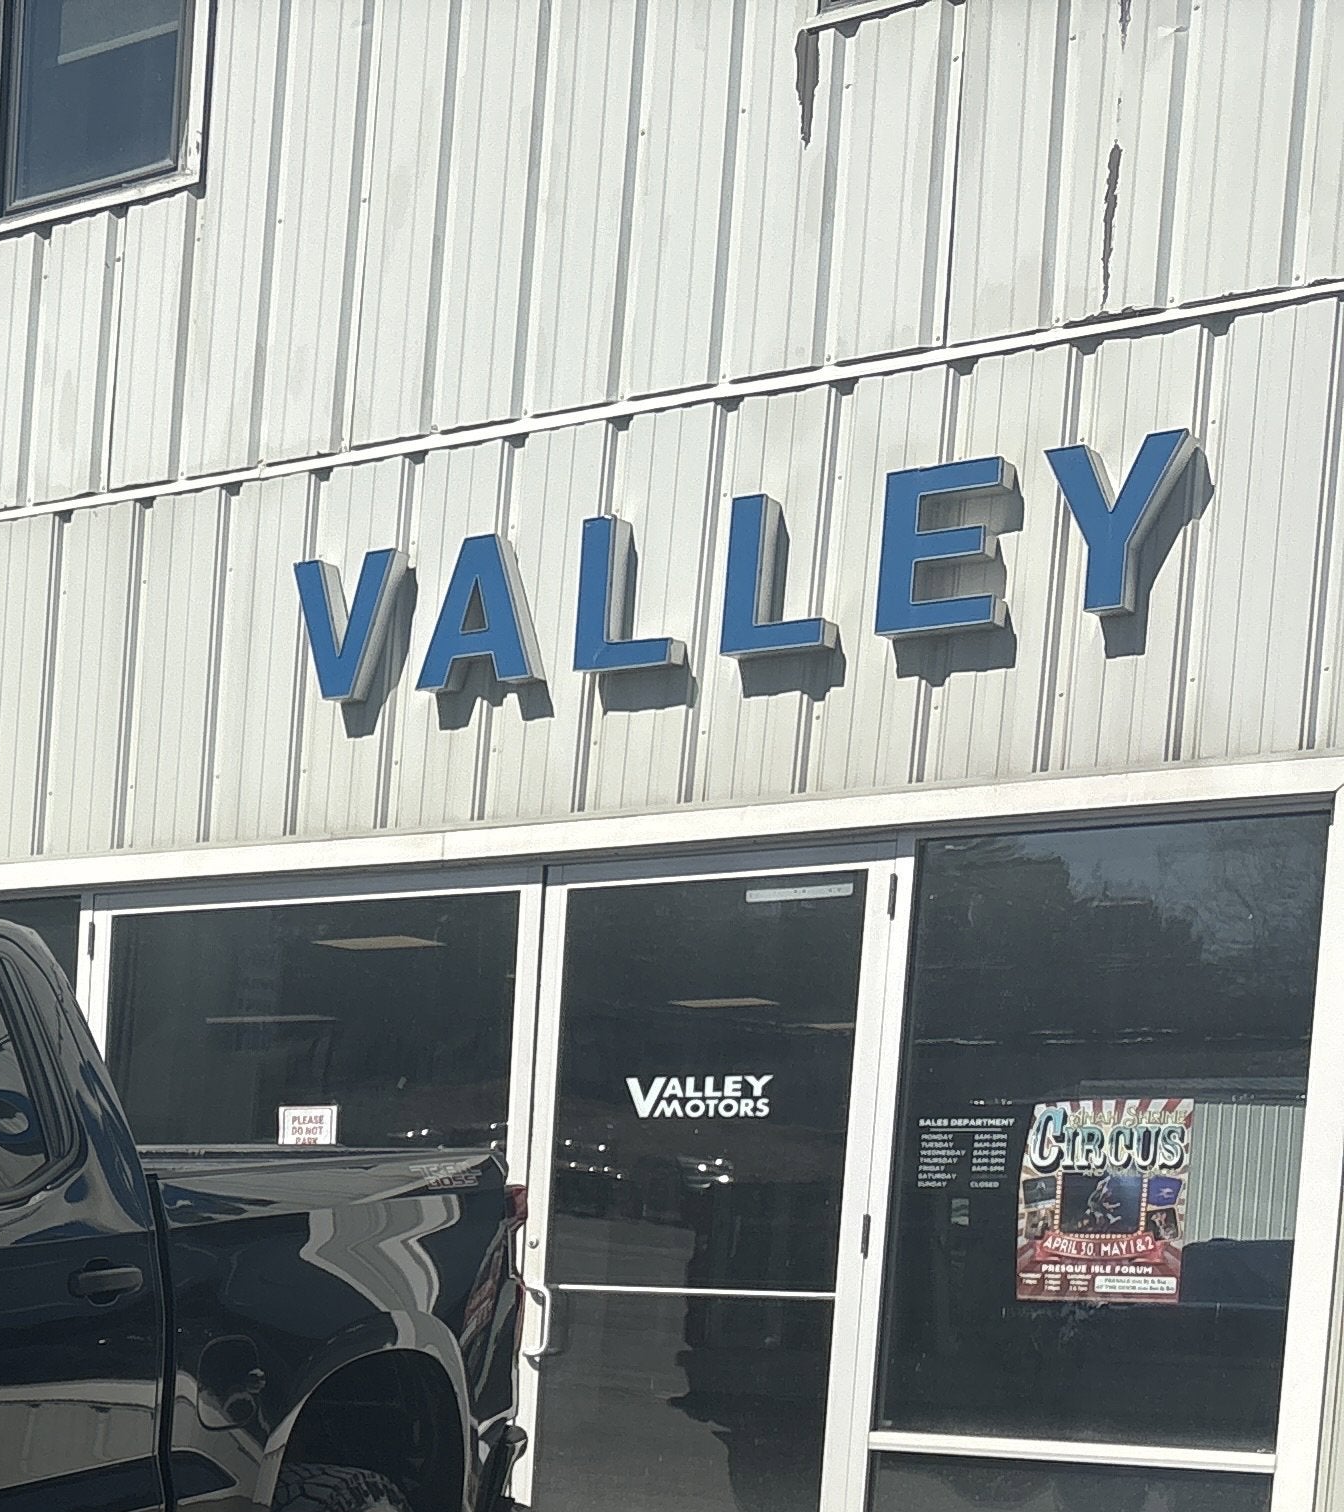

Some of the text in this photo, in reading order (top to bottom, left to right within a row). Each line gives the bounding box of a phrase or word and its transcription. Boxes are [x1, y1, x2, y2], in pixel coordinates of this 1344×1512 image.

[294, 428, 1198, 702] VALLEY
[625, 1074, 774, 1118] VALLEY
[652, 1098, 770, 1118] MOTORS
[291, 1115, 324, 1125] PLEASE
[918, 1118, 1015, 1126] SALES DEPARTMENT
[291, 1126, 324, 1135] DO NOT
[1030, 1106, 1186, 1171] CIRCUS
[425, 1175, 480, 1190] BOSS
[1043, 1235, 1077, 1254] APRIL
[1100, 1241, 1130, 1256] MAY
[1136, 1240, 1146, 1251] &
[1144, 1236, 1154, 1250] 2
[1041, 1264, 1152, 1274] PRESQUE ISLE FORUM
